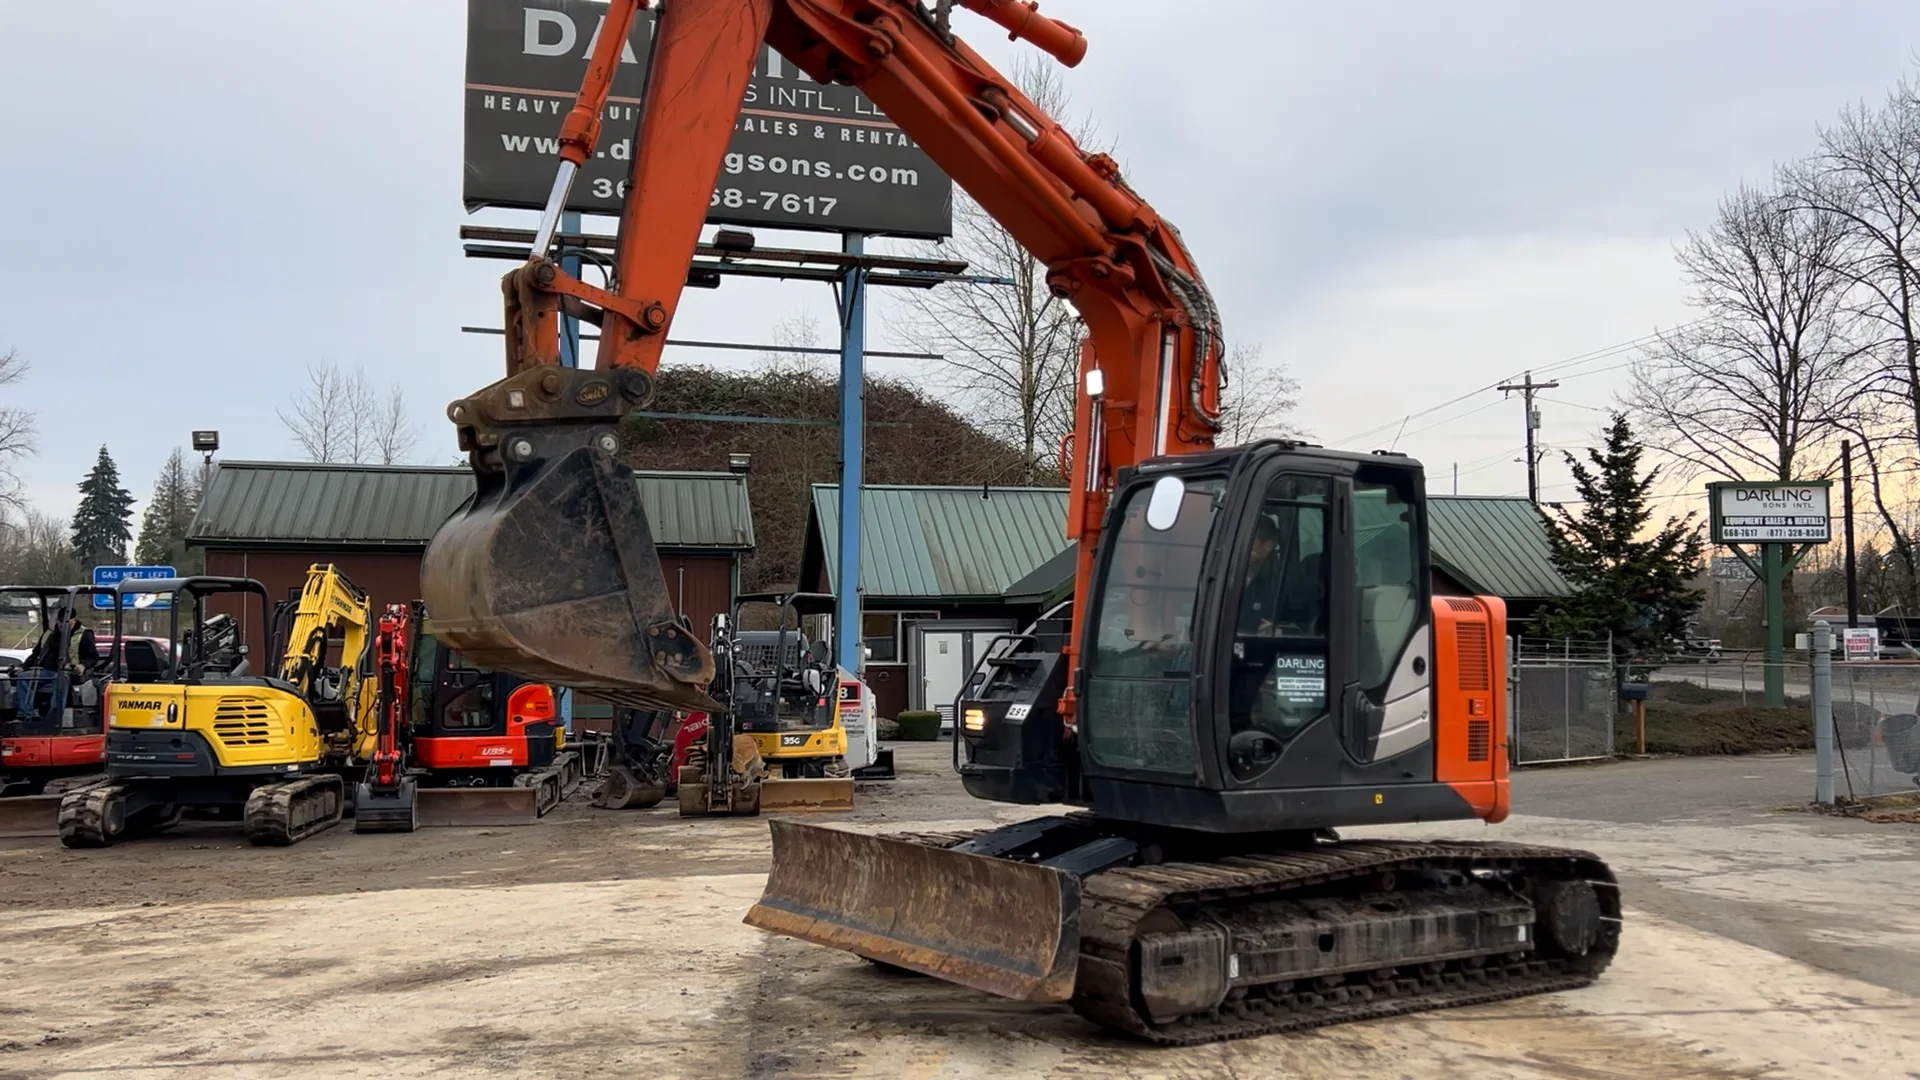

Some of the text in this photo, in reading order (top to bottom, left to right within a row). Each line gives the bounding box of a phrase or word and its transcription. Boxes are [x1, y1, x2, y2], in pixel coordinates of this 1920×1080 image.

[770, 86, 841, 112] INTL.
[855, 96, 887, 116] LL
[484, 95, 561, 115] HEAVY
[735, 118, 798, 136] ALES
[814, 125, 825, 139] &
[1736, 489, 1812, 501] DARLING
[1725, 517, 1824, 526] EQUIPMENT SALES & RENTALS
[1766, 529, 1786, 537] (877)
[101, 571, 118, 579] GAS
[1277, 658, 1325, 669] DARLING
[117, 700, 162, 710] YANMAR
[783, 737, 800, 745] 35G
